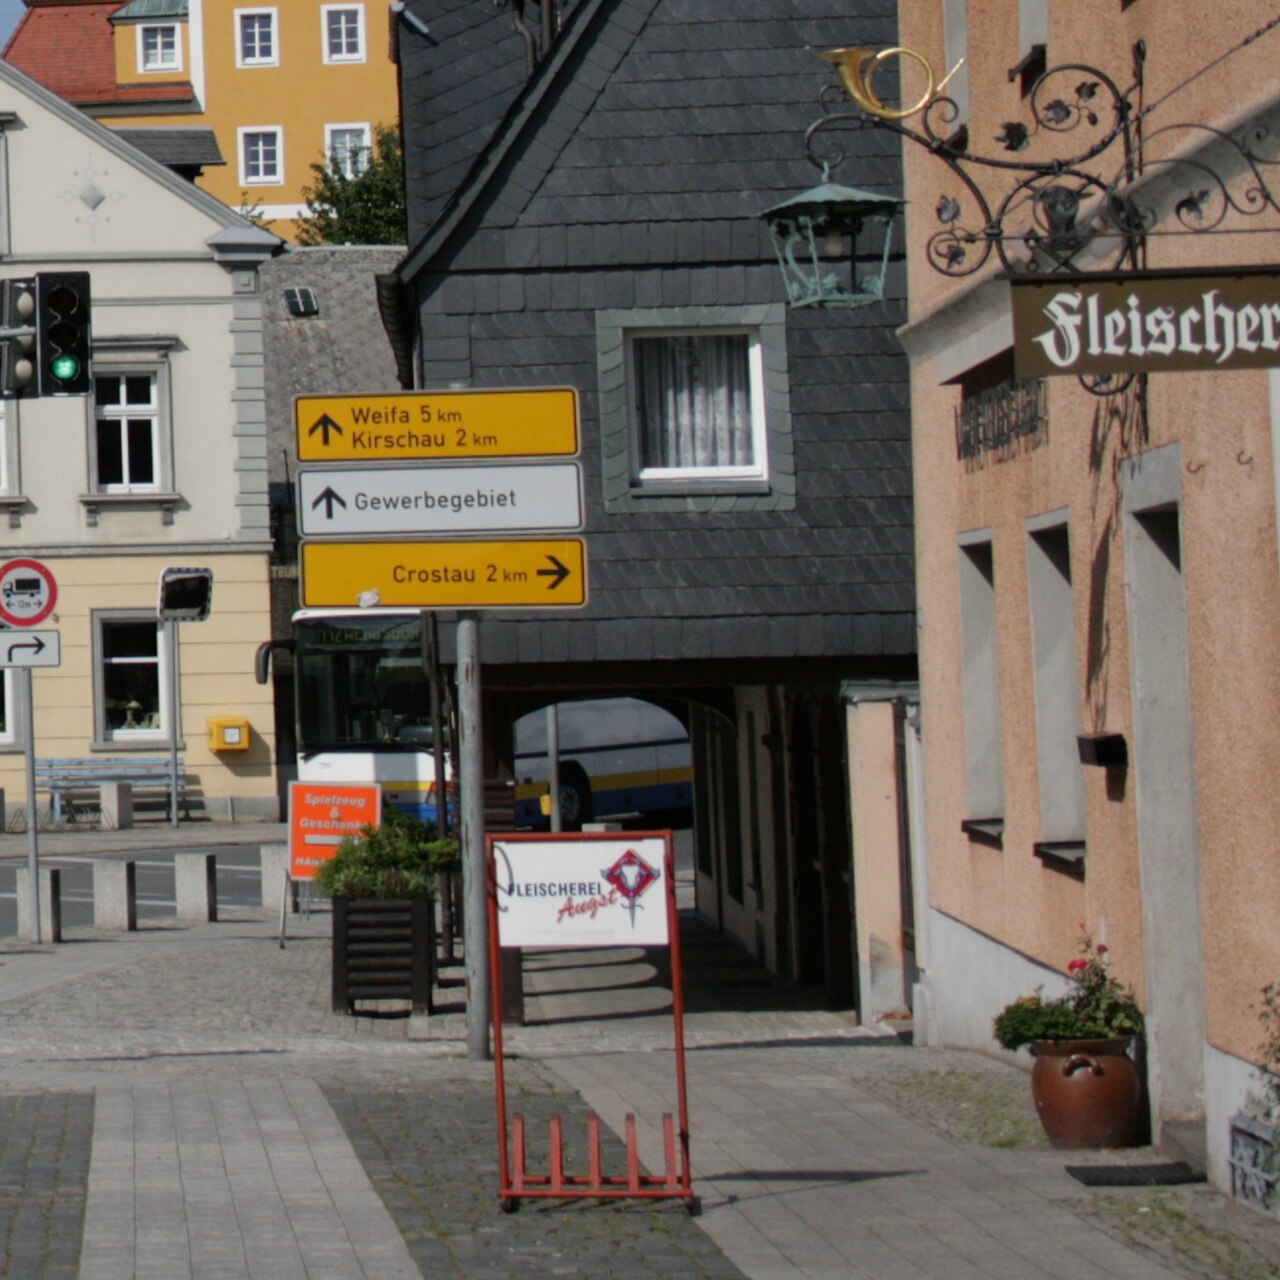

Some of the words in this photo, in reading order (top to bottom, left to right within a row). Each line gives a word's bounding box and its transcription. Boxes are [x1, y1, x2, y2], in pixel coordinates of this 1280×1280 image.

[351, 405, 410, 425] Weifa
[420, 404, 432, 423] 5
[437, 408, 462, 423] km
[352, 429, 445, 449] Kirschau
[456, 428, 467, 447] 2
[473, 432, 498, 446] km
[354, 489, 517, 513] Gewerbegebiet
[392, 564, 476, 583] Crostau
[486, 564, 497, 582] 2
[503, 569, 528, 582] km
[304, 792, 366, 808] Spielzeug
[329, 807, 340, 818] &
[508, 882, 602, 897] FLEISCHEREI
[556, 886, 618, 923] Augst
